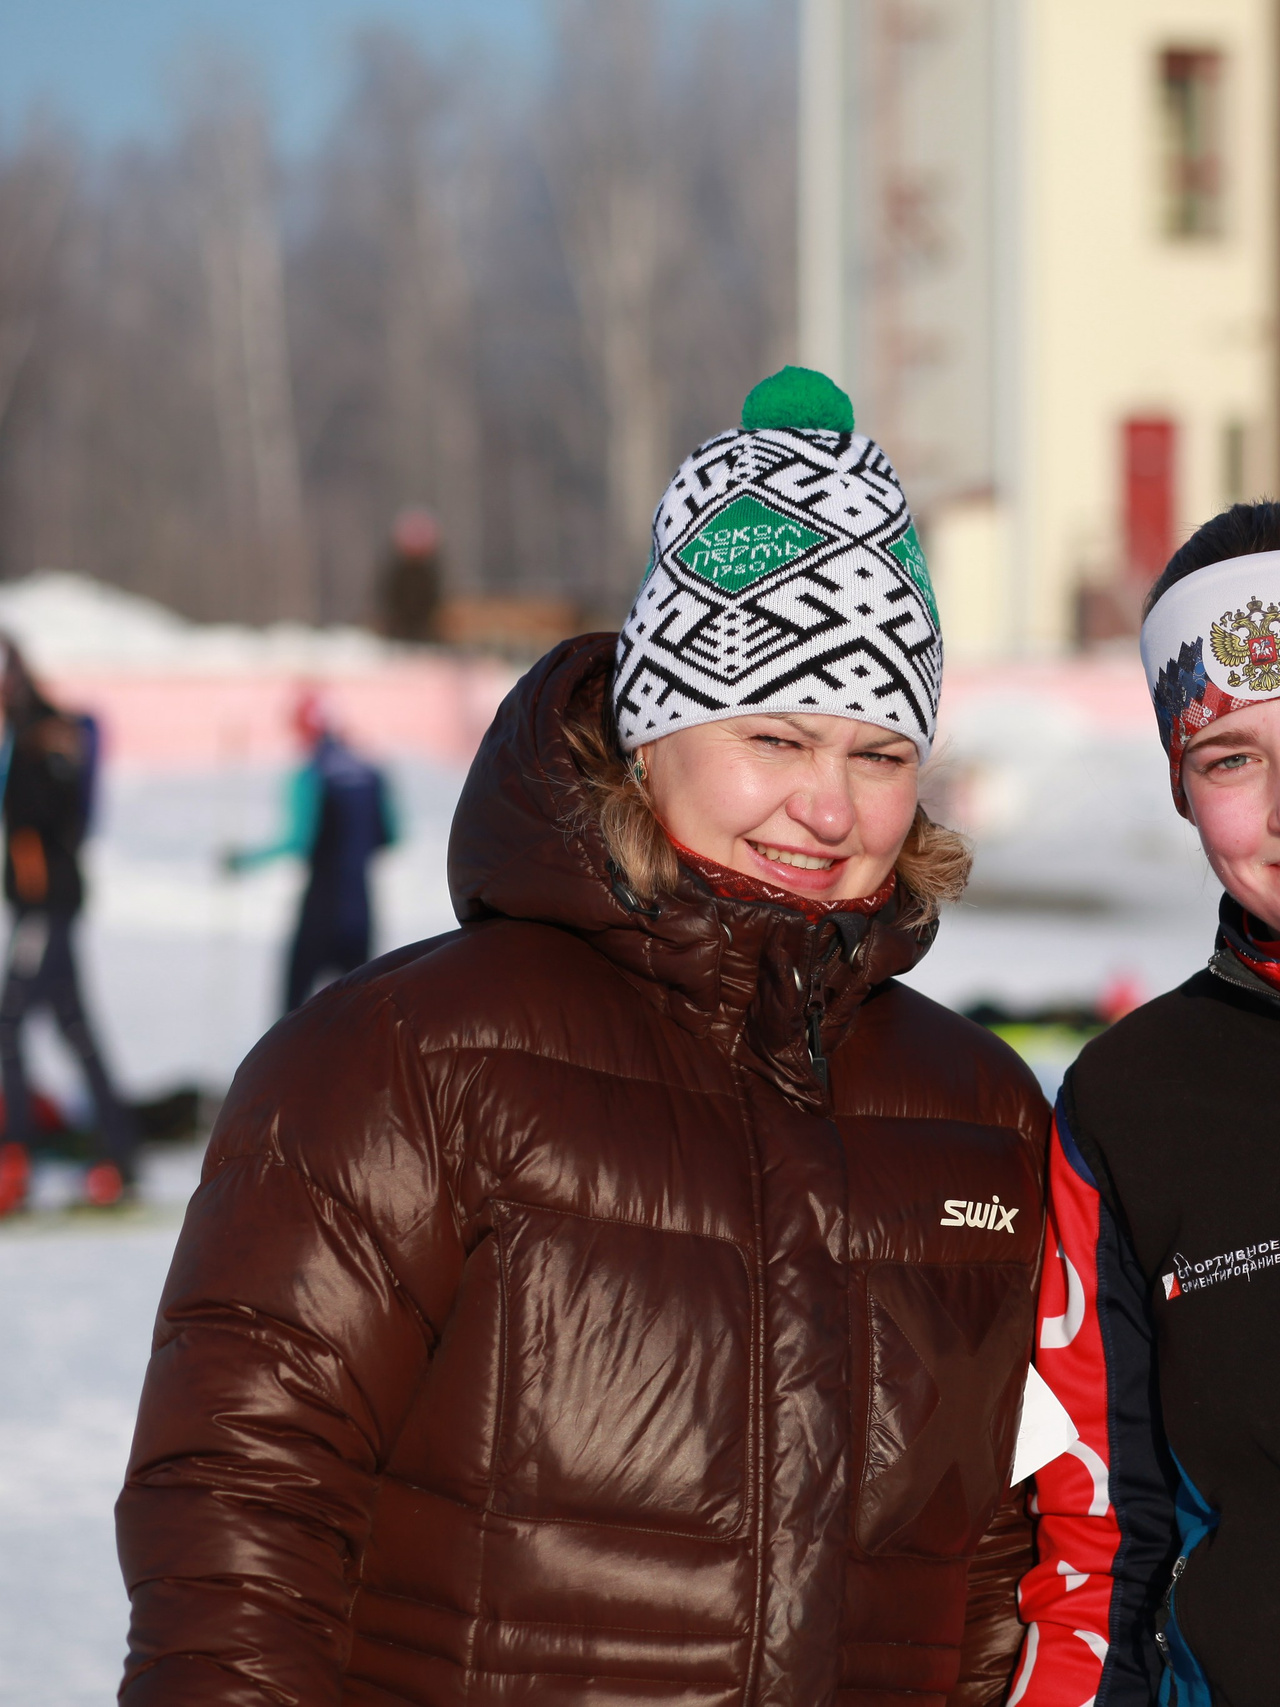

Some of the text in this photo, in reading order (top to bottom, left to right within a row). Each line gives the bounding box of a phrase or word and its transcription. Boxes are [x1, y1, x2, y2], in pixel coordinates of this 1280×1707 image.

[698, 523, 801, 548] СОКОЛ
[691, 541, 805, 572] ПЕРМЬ
[1178, 1240, 1280, 1279] СПОРТИВНОЕ
